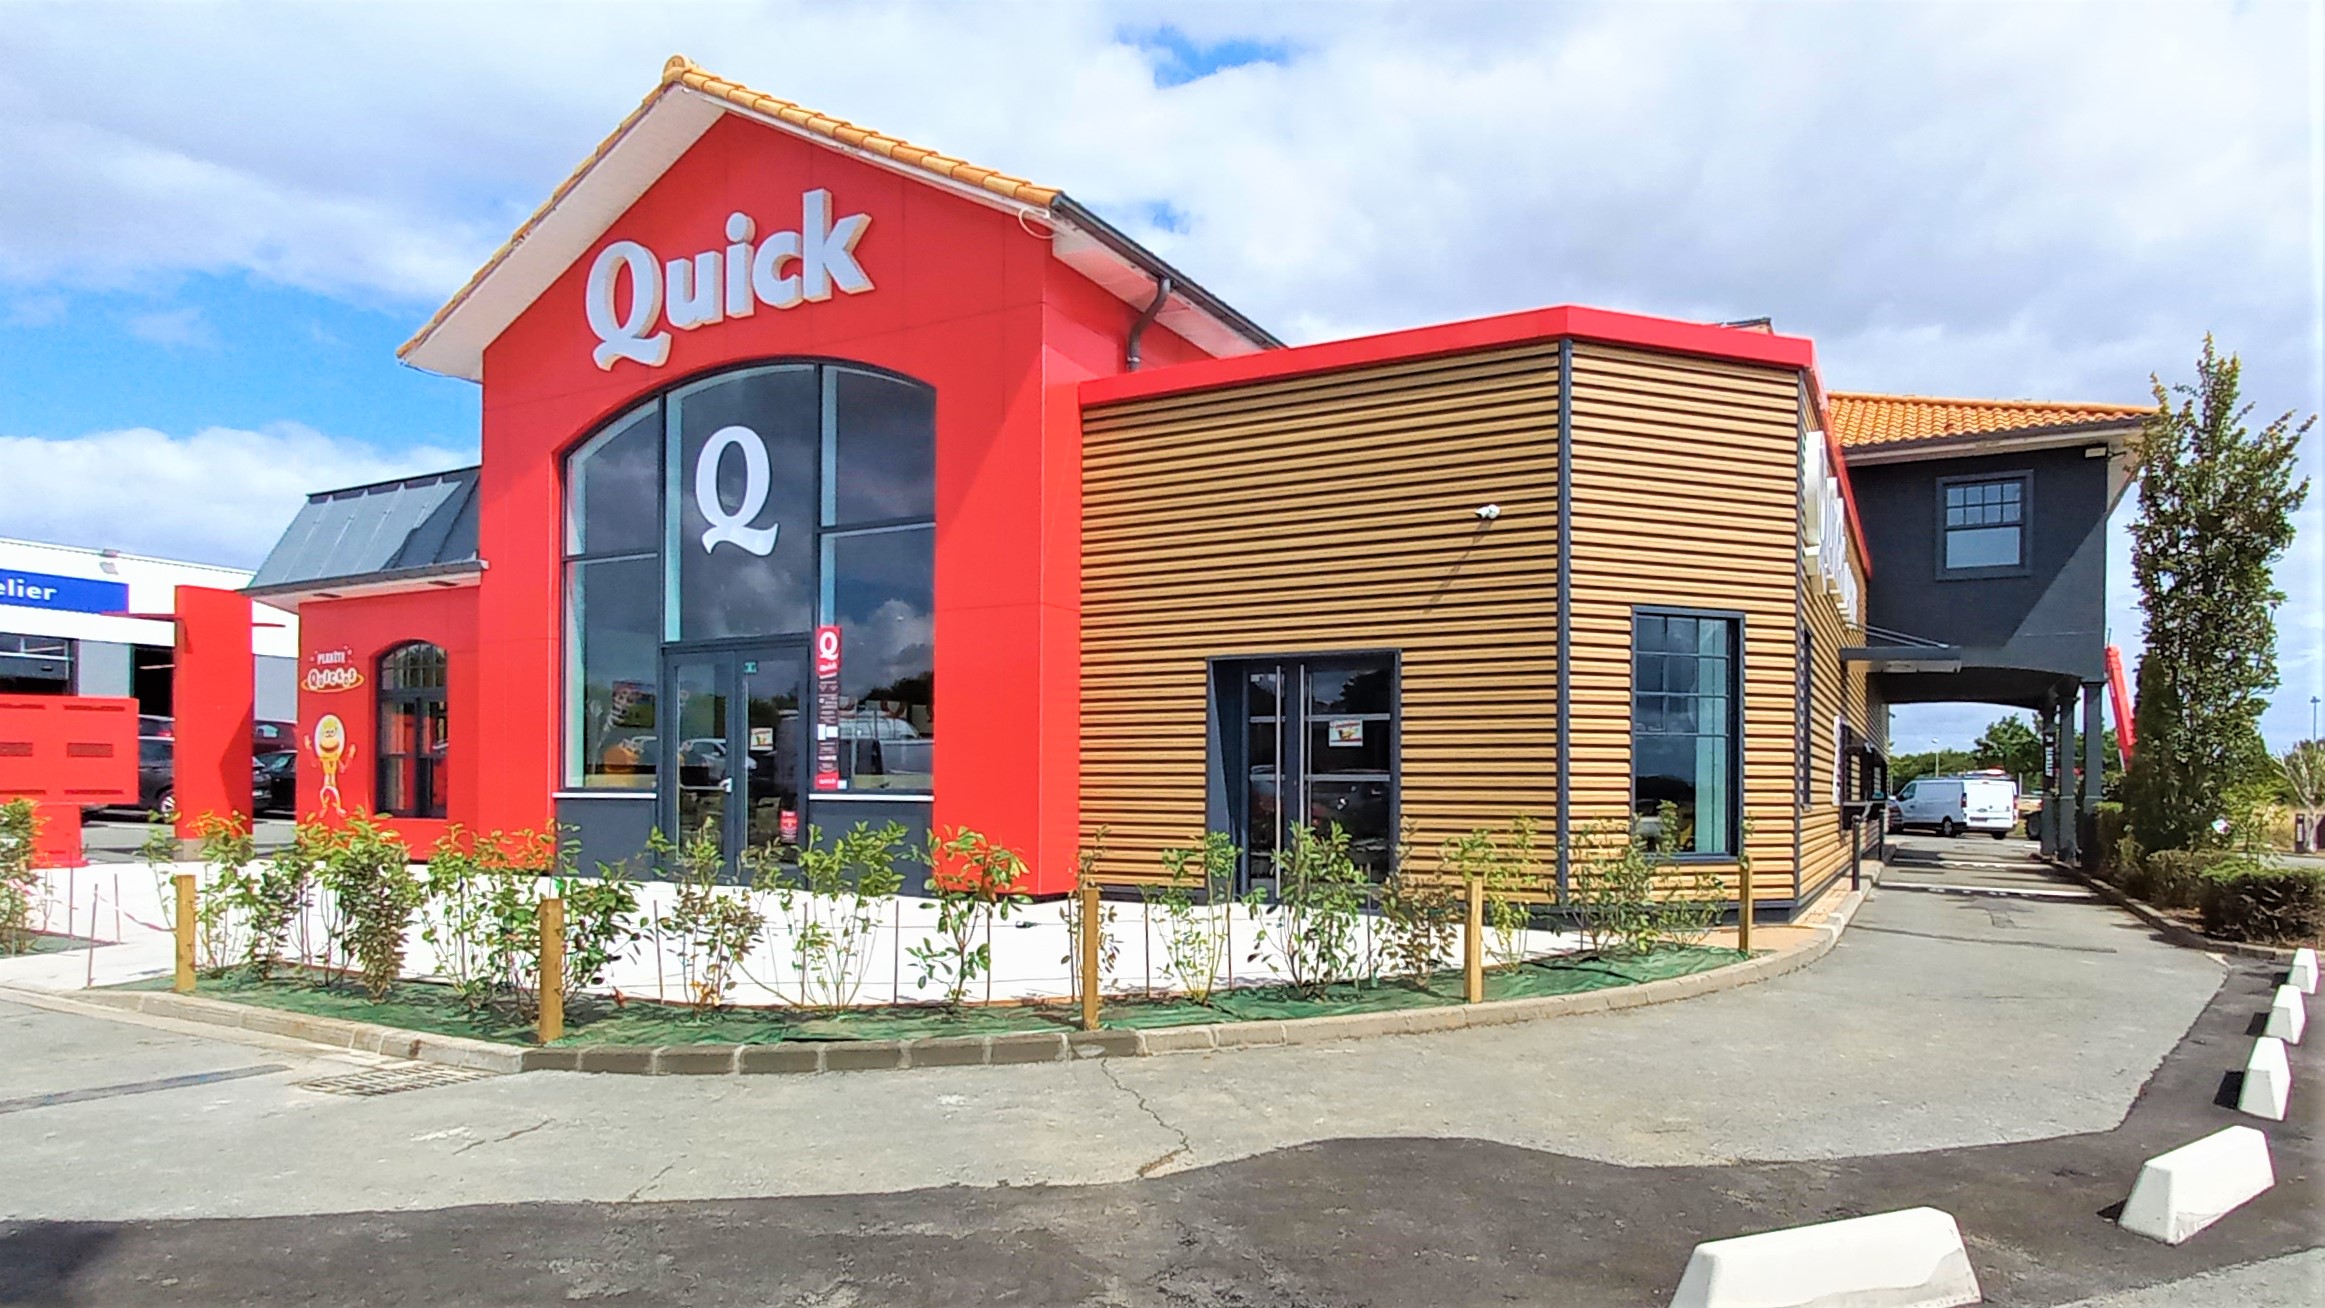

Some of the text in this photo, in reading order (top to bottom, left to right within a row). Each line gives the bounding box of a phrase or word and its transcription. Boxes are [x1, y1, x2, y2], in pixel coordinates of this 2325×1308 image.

[585, 188, 876, 372] Quick
[695, 425, 779, 557] Q
[308, 667, 358, 690] QUICKOS
[819, 631, 839, 660] Q
